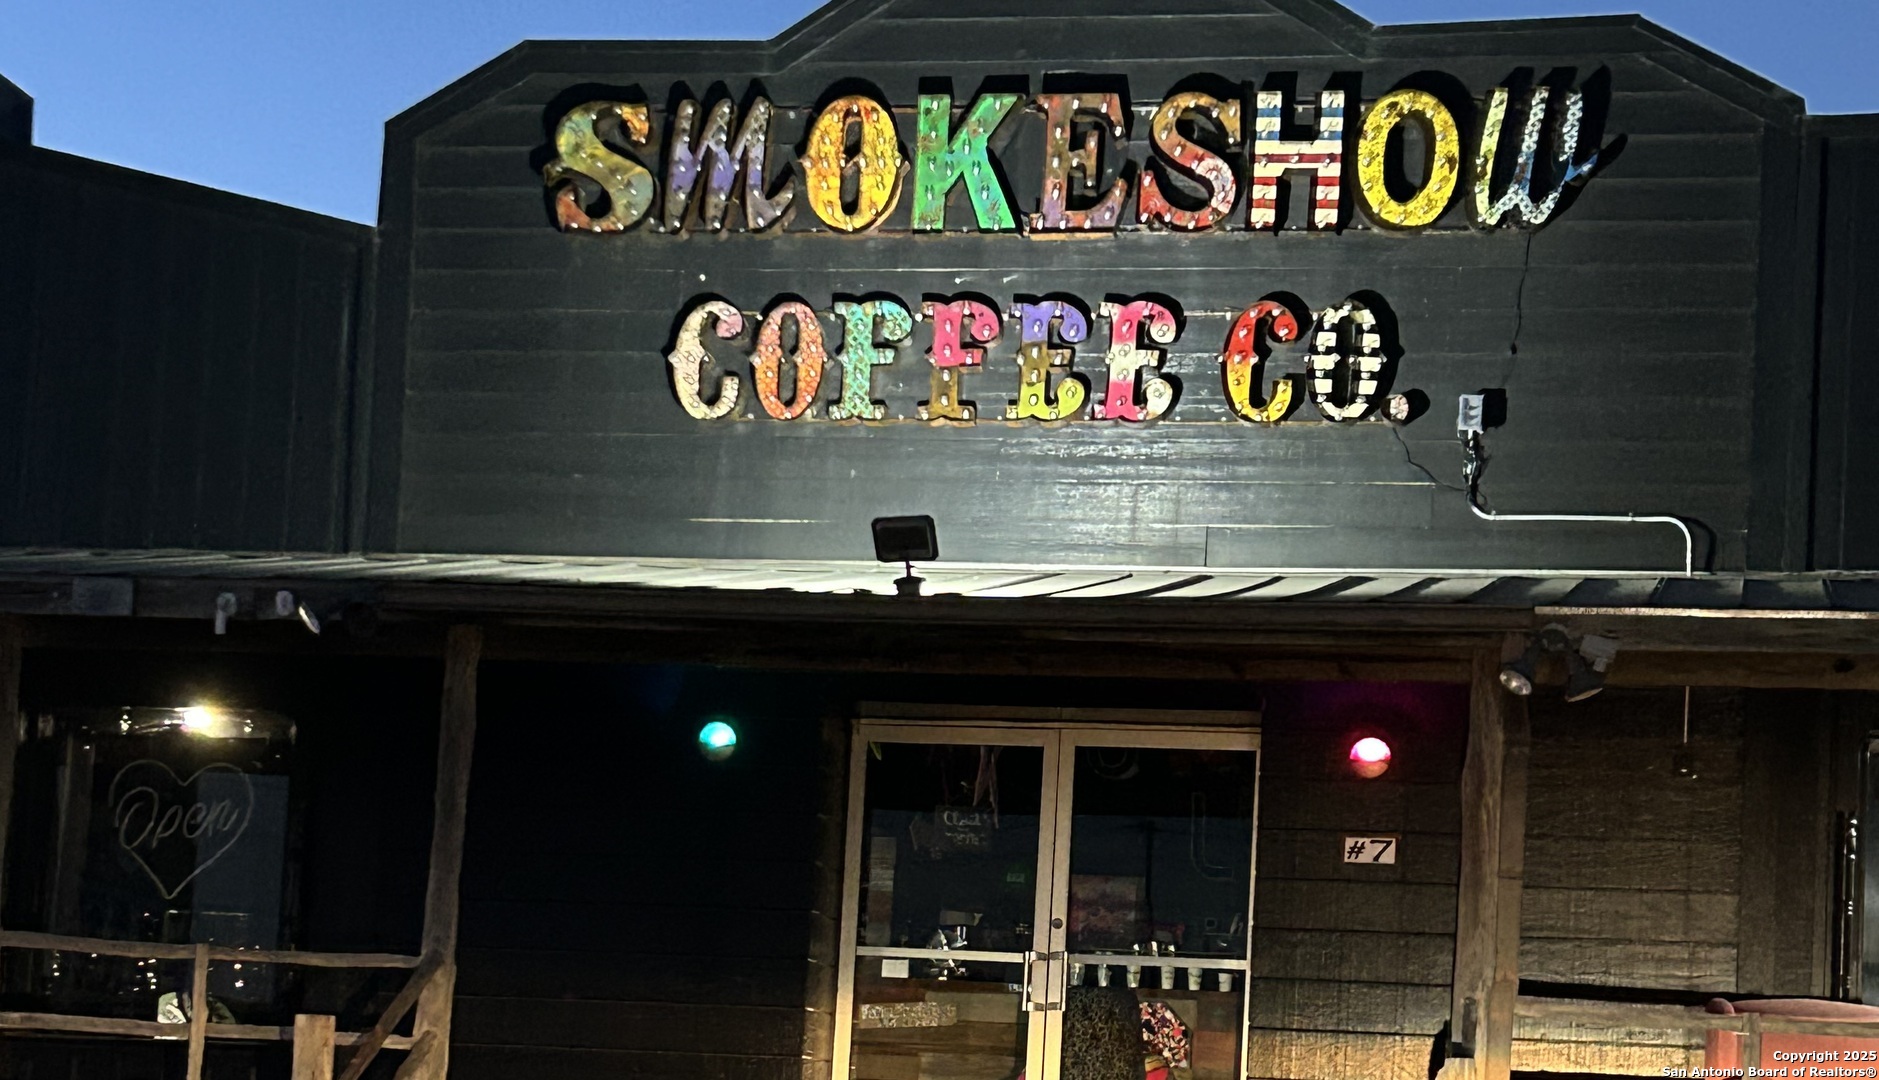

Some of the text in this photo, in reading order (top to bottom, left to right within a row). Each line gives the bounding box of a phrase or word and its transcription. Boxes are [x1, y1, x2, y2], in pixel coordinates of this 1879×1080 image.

[543, 86, 1599, 234] SMOKESHOW
[668, 299, 1411, 423] COFFEE CO.
[115, 786, 239, 849] Open
[1346, 839, 1394, 862] #7
